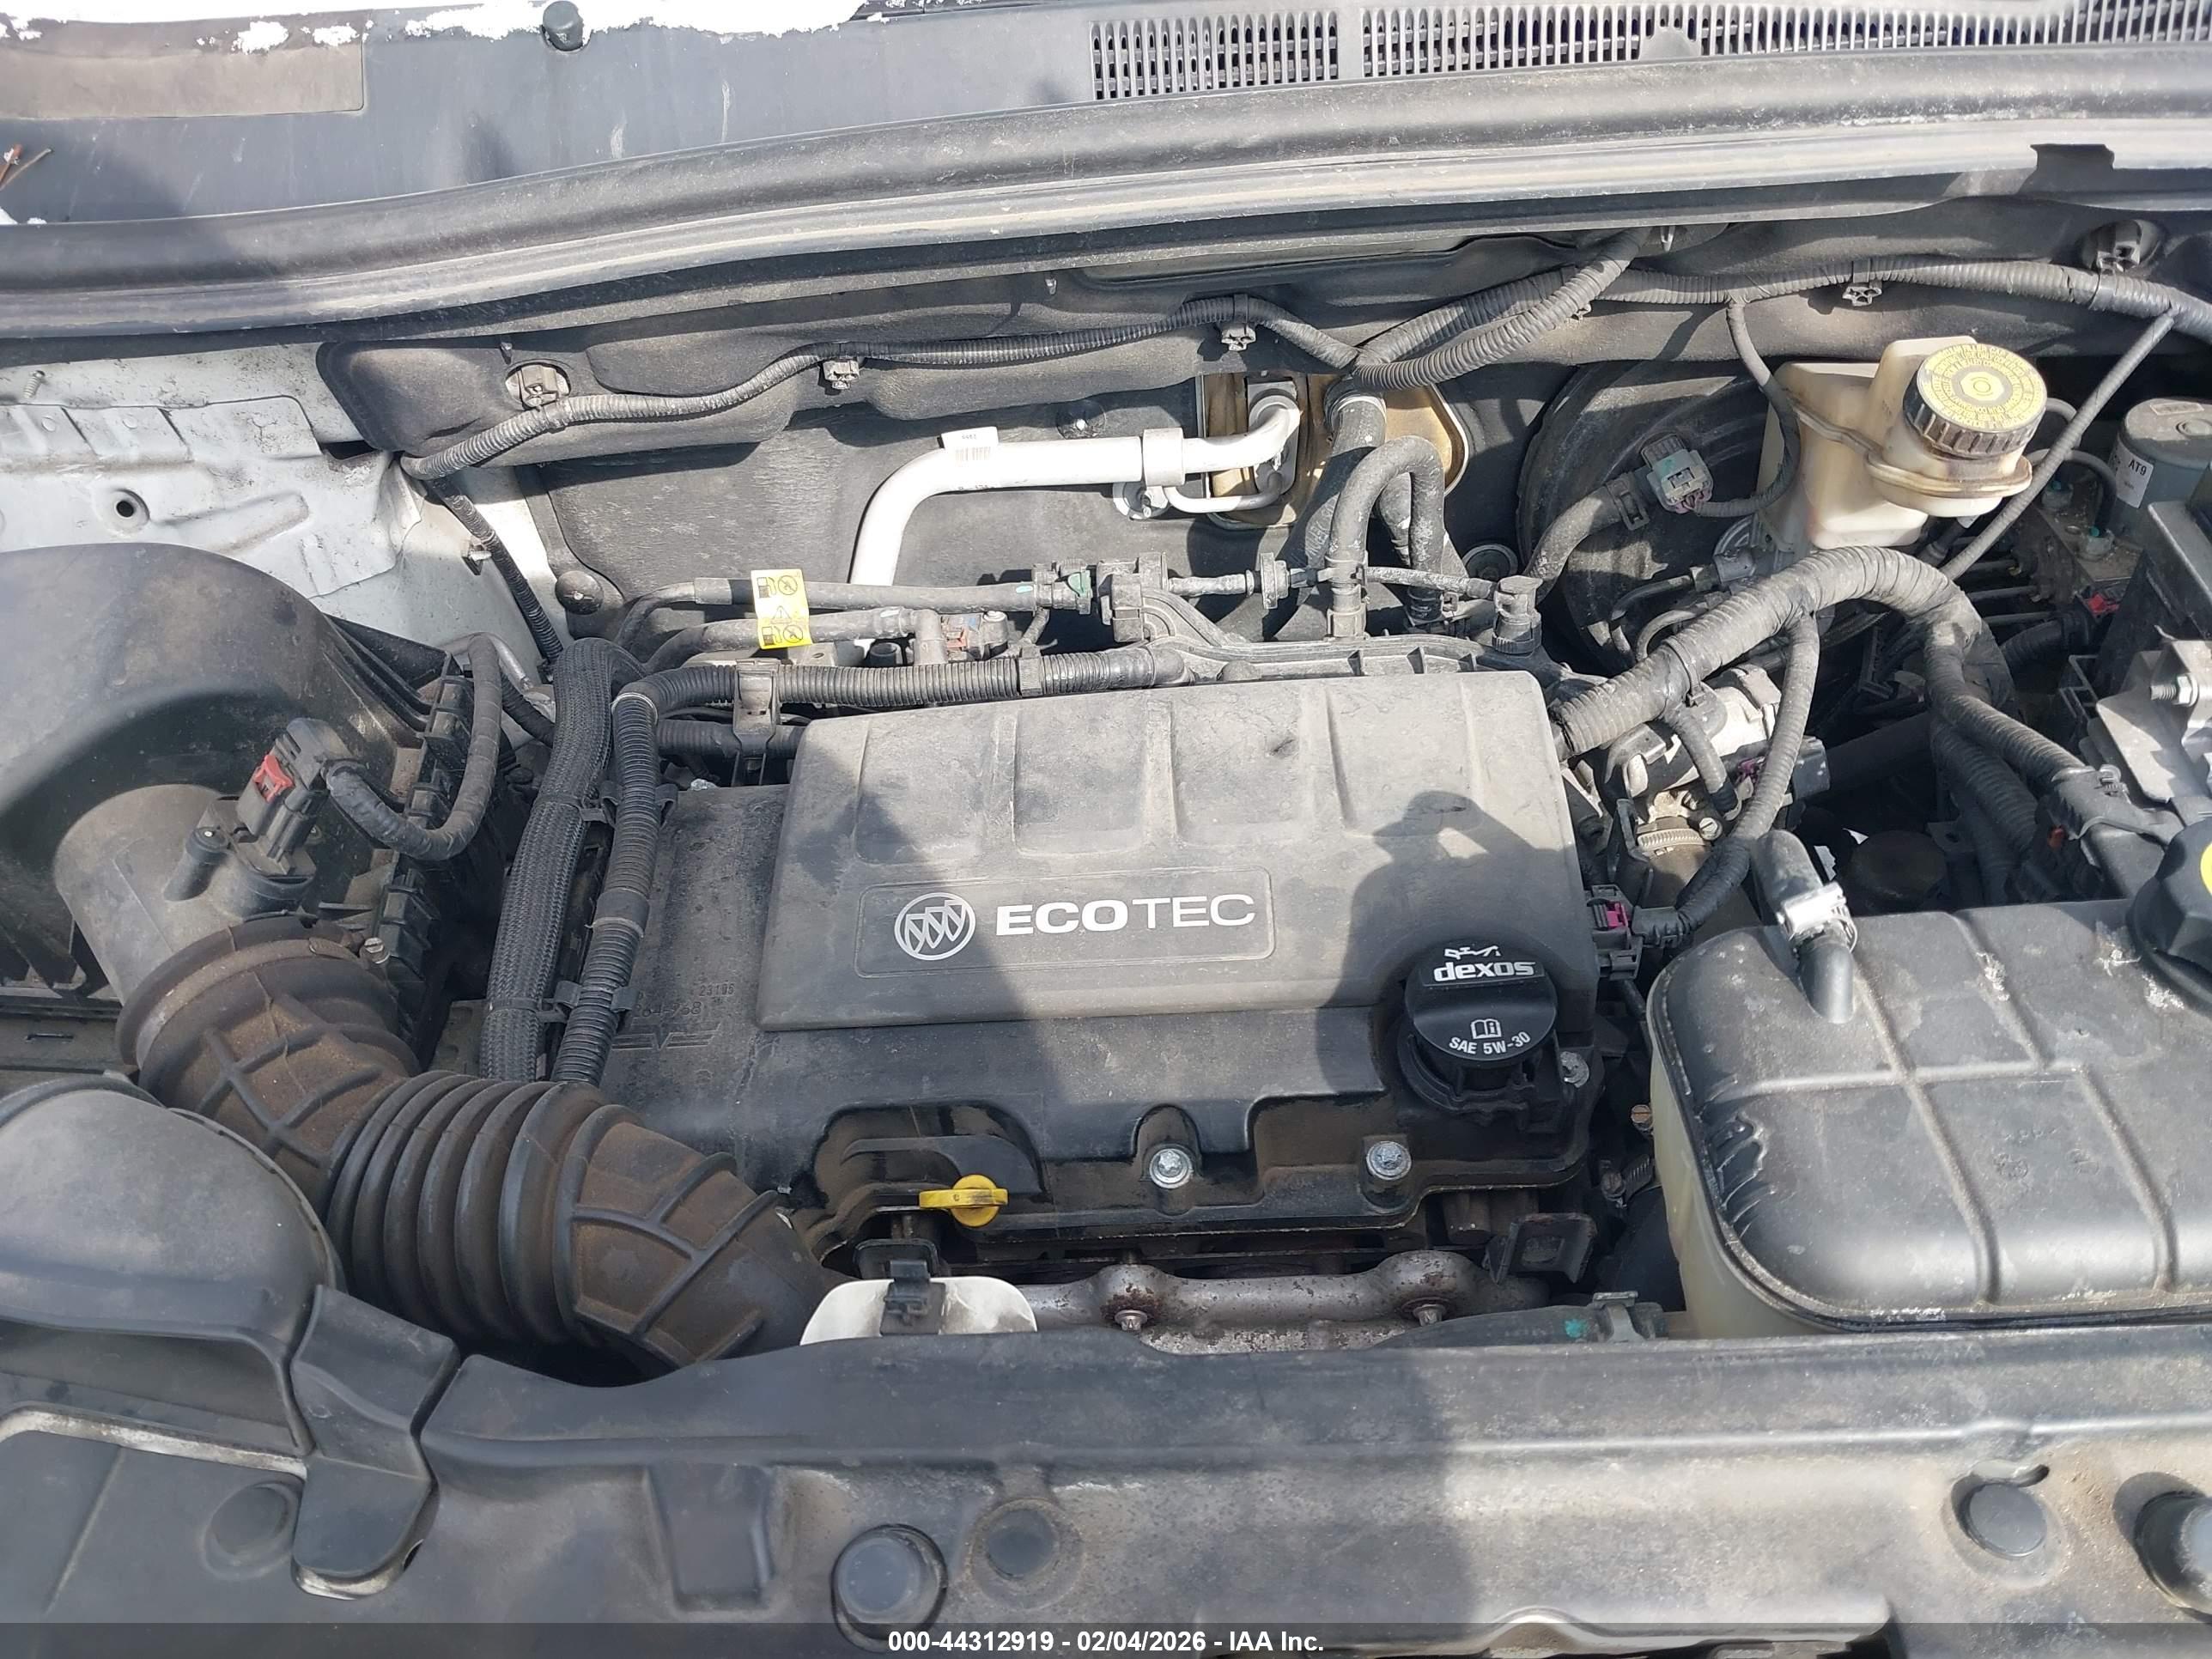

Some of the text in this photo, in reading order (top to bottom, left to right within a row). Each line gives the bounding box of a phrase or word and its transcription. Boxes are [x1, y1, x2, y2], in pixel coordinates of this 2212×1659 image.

[2128, 459, 2148, 477] AT9
[996, 894, 1255, 936] ECOTEC
[1433, 961, 1536, 982] dexos
[1449, 1030, 1531, 1054] SAE 5W-30
